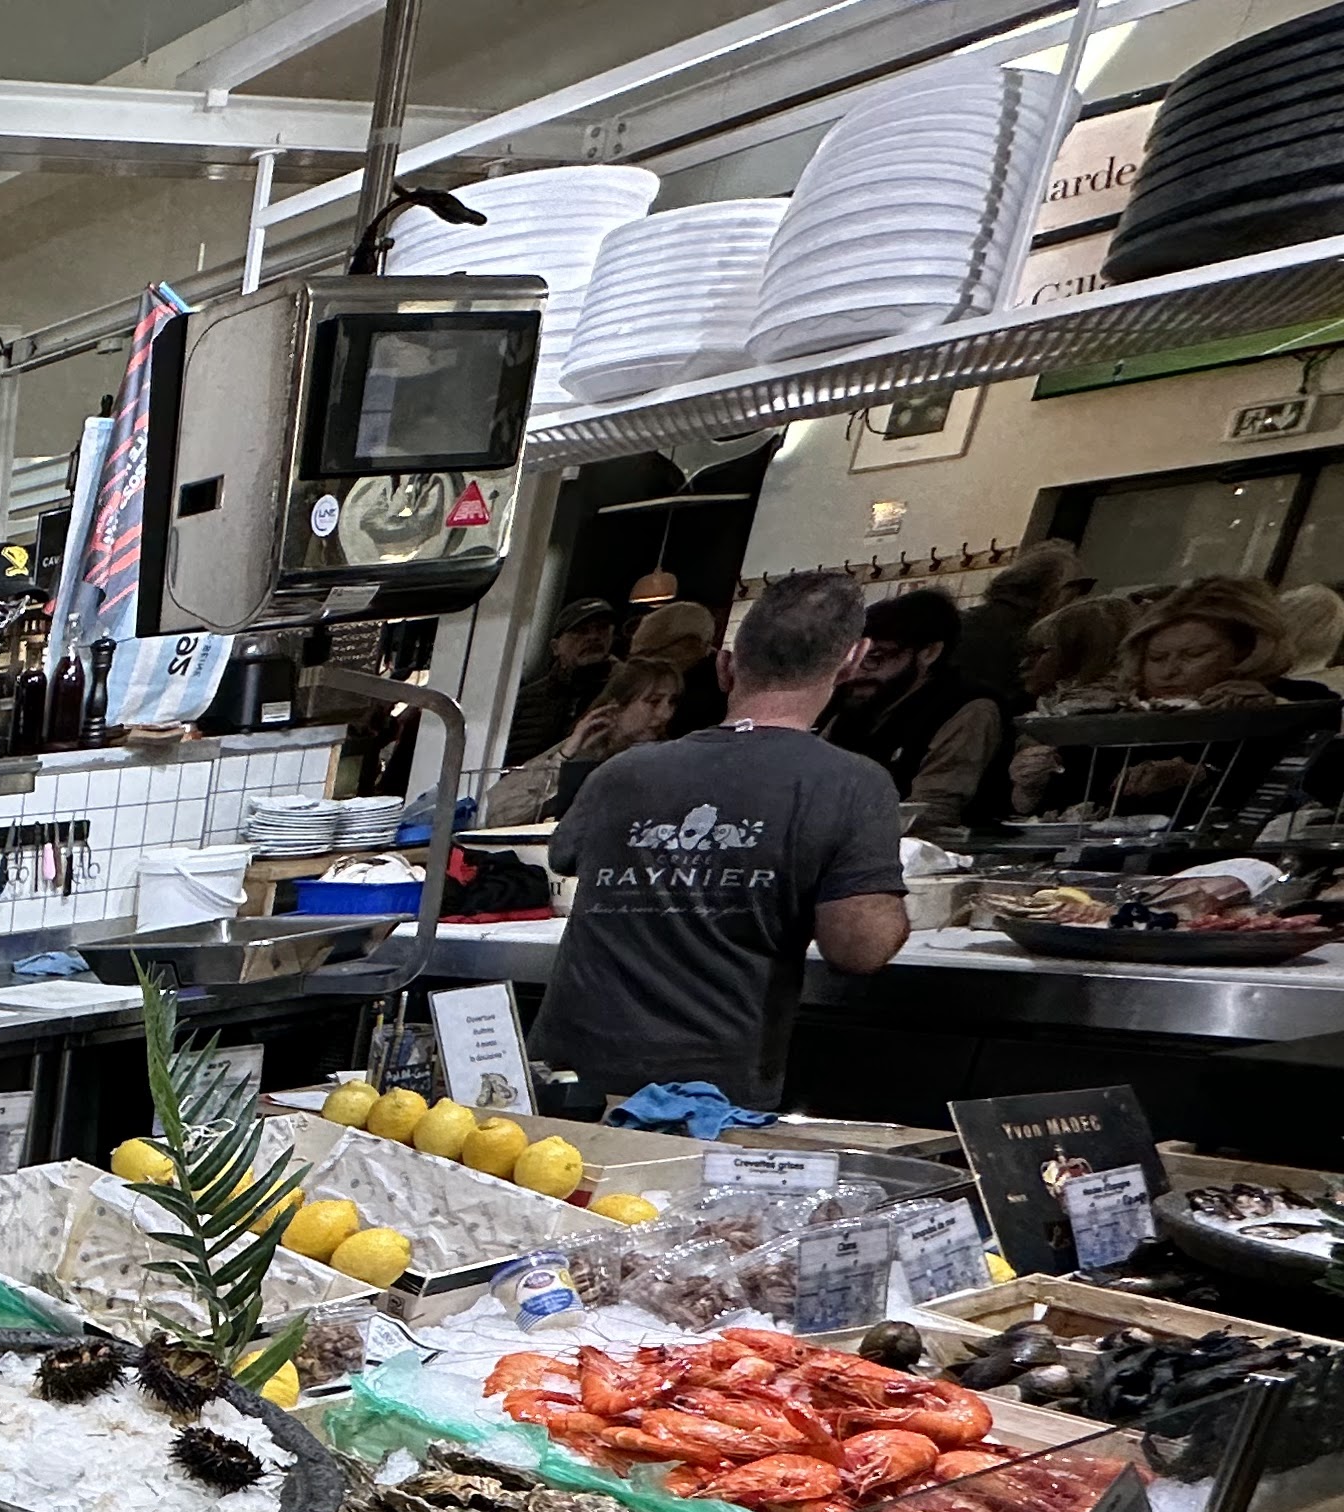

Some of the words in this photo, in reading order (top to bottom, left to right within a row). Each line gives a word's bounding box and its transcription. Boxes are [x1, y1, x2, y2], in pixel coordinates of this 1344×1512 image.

[596, 867, 776, 888] RAYNIER
[1001, 1121, 1042, 1141] Yvon
[1045, 1114, 1102, 1136] MADEC
